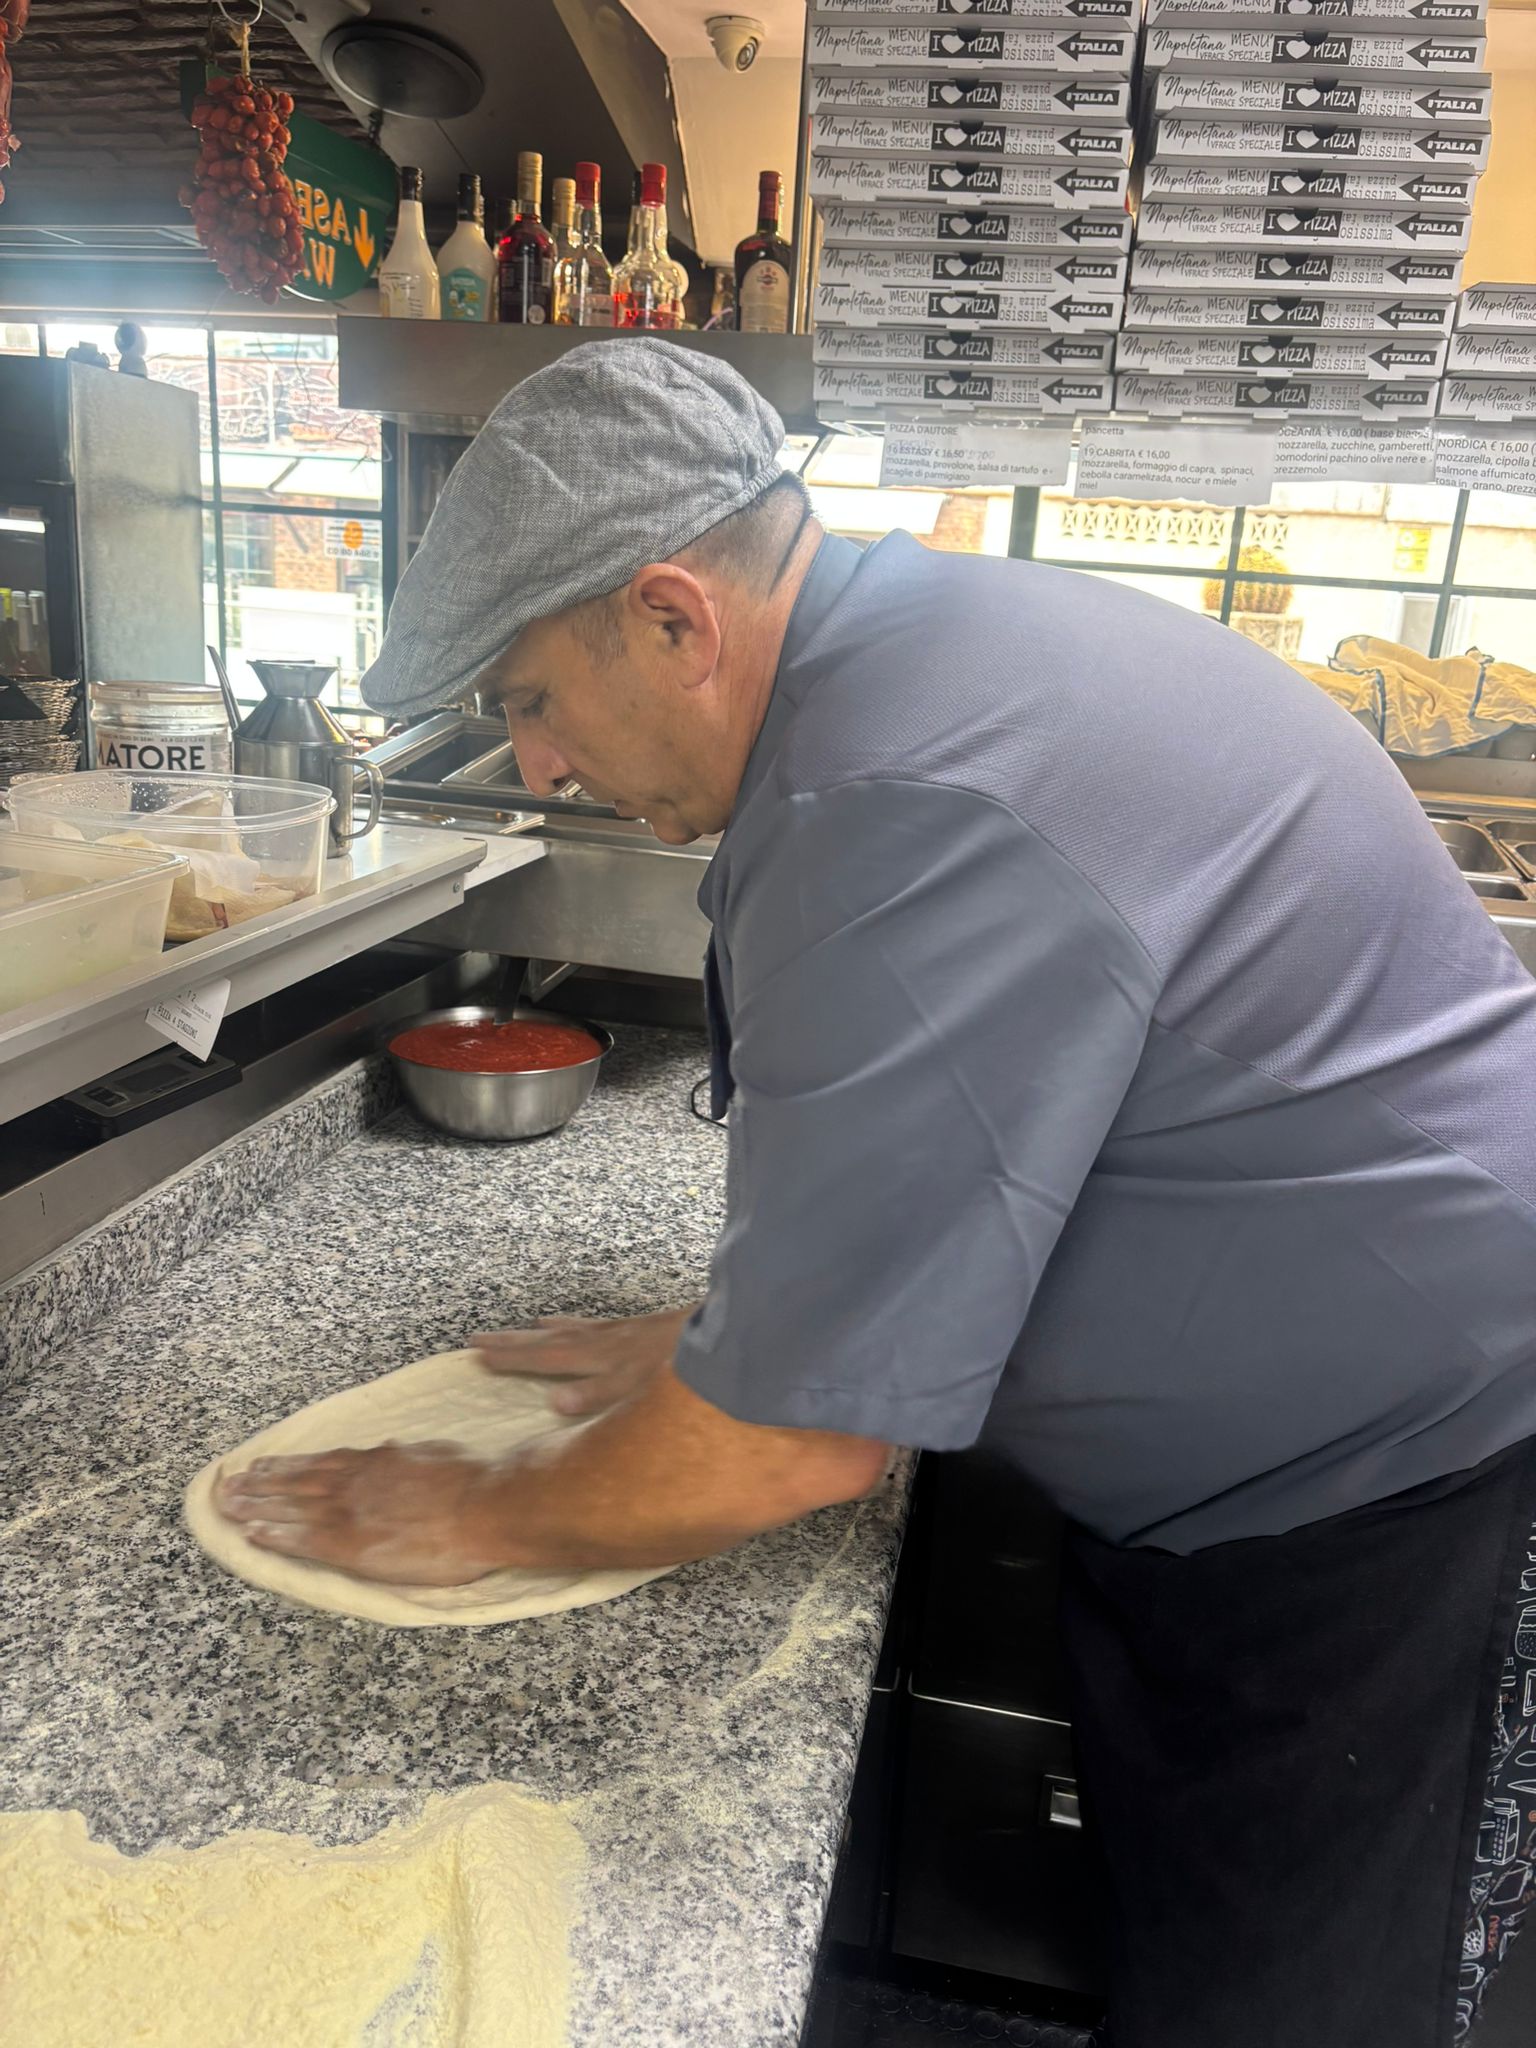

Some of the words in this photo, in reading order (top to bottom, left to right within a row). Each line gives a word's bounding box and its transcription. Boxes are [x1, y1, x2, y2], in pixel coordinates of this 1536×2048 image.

[976, 0, 1009, 12] PIZZA
[1077, 3, 1126, 14] ITALIA
[1315, 0, 1349, 16] PIZZA
[1421, 7, 1472, 18] ITALIA
[814, 27, 884, 57] Napoletana
[968, 35, 1000, 54] PIZZA
[1069, 41, 1118, 54] ITALIA
[1153, 29, 1225, 59] Napoletana
[1276, 40, 1286, 56] I
[1313, 40, 1348, 59] PIZZA
[886, 45, 927, 58] SPECIALE
[1228, 49, 1271, 61] SPECIALE
[1419, 48, 1470, 61] ITALIA
[816, 78, 884, 104] Napoletana
[966, 86, 998, 103] PIZZA
[1164, 76, 1236, 105] Napoletana
[1286, 88, 1296, 104] I
[1323, 89, 1357, 107] PIZZA
[1066, 93, 1114, 104] ITALIA
[1239, 96, 1281, 108] SPECIALE
[1427, 99, 1477, 111] ITALIA
[818, 117, 888, 145] Napoletana
[970, 129, 1002, 146] PIZZA
[1163, 121, 1236, 150] Napoletana
[890, 136, 930, 147] SPECIALE
[1069, 138, 1117, 150] ITALIA
[1238, 140, 1280, 152] SPECIALE
[1323, 132, 1357, 150] PIZZA
[1427, 141, 1476, 153] ITALIA
[815, 160, 884, 189] Napoletana
[966, 170, 999, 188] PIZZA
[1151, 167, 1222, 192] Napoletana
[1066, 178, 1113, 190] ITALIA
[1308, 177, 1342, 193] PIZZA
[1412, 185, 1462, 195] ITALIA
[828, 210, 895, 236] Napoletana
[974, 219, 1006, 235] PIZZA
[1145, 207, 1217, 235] Napoletana
[1304, 215, 1337, 233] PIZZA
[1408, 222, 1457, 234] ITALIA
[1071, 226, 1118, 237] ITALIA
[1219, 224, 1261, 236] SPECIALE
[824, 252, 891, 277] Napoletana
[970, 260, 1002, 276] PIZZA
[1066, 266, 1112, 277] ITALIA
[1138, 253, 1209, 281] Napoletana
[1296, 260, 1328, 278] PIZZA
[1399, 266, 1447, 278] ITALIA
[1211, 269, 1253, 281] SPECIALE
[819, 289, 886, 315] Napoletana
[931, 298, 940, 312] I
[965, 297, 996, 314] PIZZA
[888, 306, 927, 317] SPECIALE
[1061, 304, 1108, 316] ITALIA
[1131, 299, 1202, 323] Napoletana
[1287, 306, 1320, 321] PIZZA
[1390, 311, 1438, 322] ITALIA
[818, 332, 883, 357] Napoletana
[960, 341, 990, 356] PIZZA
[1122, 337, 1193, 365] Napoletana
[1456, 335, 1531, 365] Napoletana
[1054, 348, 1098, 358] ITALIA
[1278, 346, 1311, 363] PIZZA
[1381, 352, 1431, 364] ITALIA
[818, 370, 884, 396] Napoletana
[960, 380, 990, 396] PIZZA
[1053, 387, 1097, 397] ITALIA
[1122, 380, 1191, 406] Napoletana
[1274, 389, 1306, 404] PIZZA
[1374, 394, 1423, 405] ITALIA
[1449, 382, 1523, 411] Napoletana
[890, 424, 915, 434] PIZZA
[917, 425, 958, 436] D'AUTORE
[1085, 426, 1124, 435] pancetta
[1337, 428, 1362, 439] 16,00
[1370, 428, 1394, 438] base
[899, 446, 933, 457] ESTASY
[1096, 447, 1135, 458] CABRITA
[1138, 449, 1144, 458] €
[1147, 449, 1170, 459] 16,00
[1331, 440, 1376, 451] zucchine,
[1379, 440, 1434, 453] gamberetti,
[1438, 438, 1487, 450] NORDICA
[1491, 441, 1497, 451] €
[1500, 442, 1529, 453] 16,00
[886, 457, 931, 468] mozzarella,
[933, 461, 975, 472] provolone,
[1001, 464, 1009, 473] di
[1011, 465, 1039, 475] tartufo
[1329, 453, 1369, 464] pachino
[1370, 453, 1394, 463] olive
[1395, 455, 1418, 463] nere
[1436, 453, 1493, 466] mozzarella,
[1495, 456, 1530, 467] cipolla
[1081, 460, 1130, 470] mozzarella,
[1132, 460, 1178, 472] formaggio
[1179, 464, 1187, 472] di
[1189, 465, 1216, 475] capra,
[1220, 464, 1254, 476] spinaci,
[1436, 466, 1478, 477] salmone
[924, 471, 970, 481] parmigiano
[1080, 470, 1112, 480] cebolla
[1212, 476, 1237, 486] miele
[1079, 481, 1098, 490] miel
